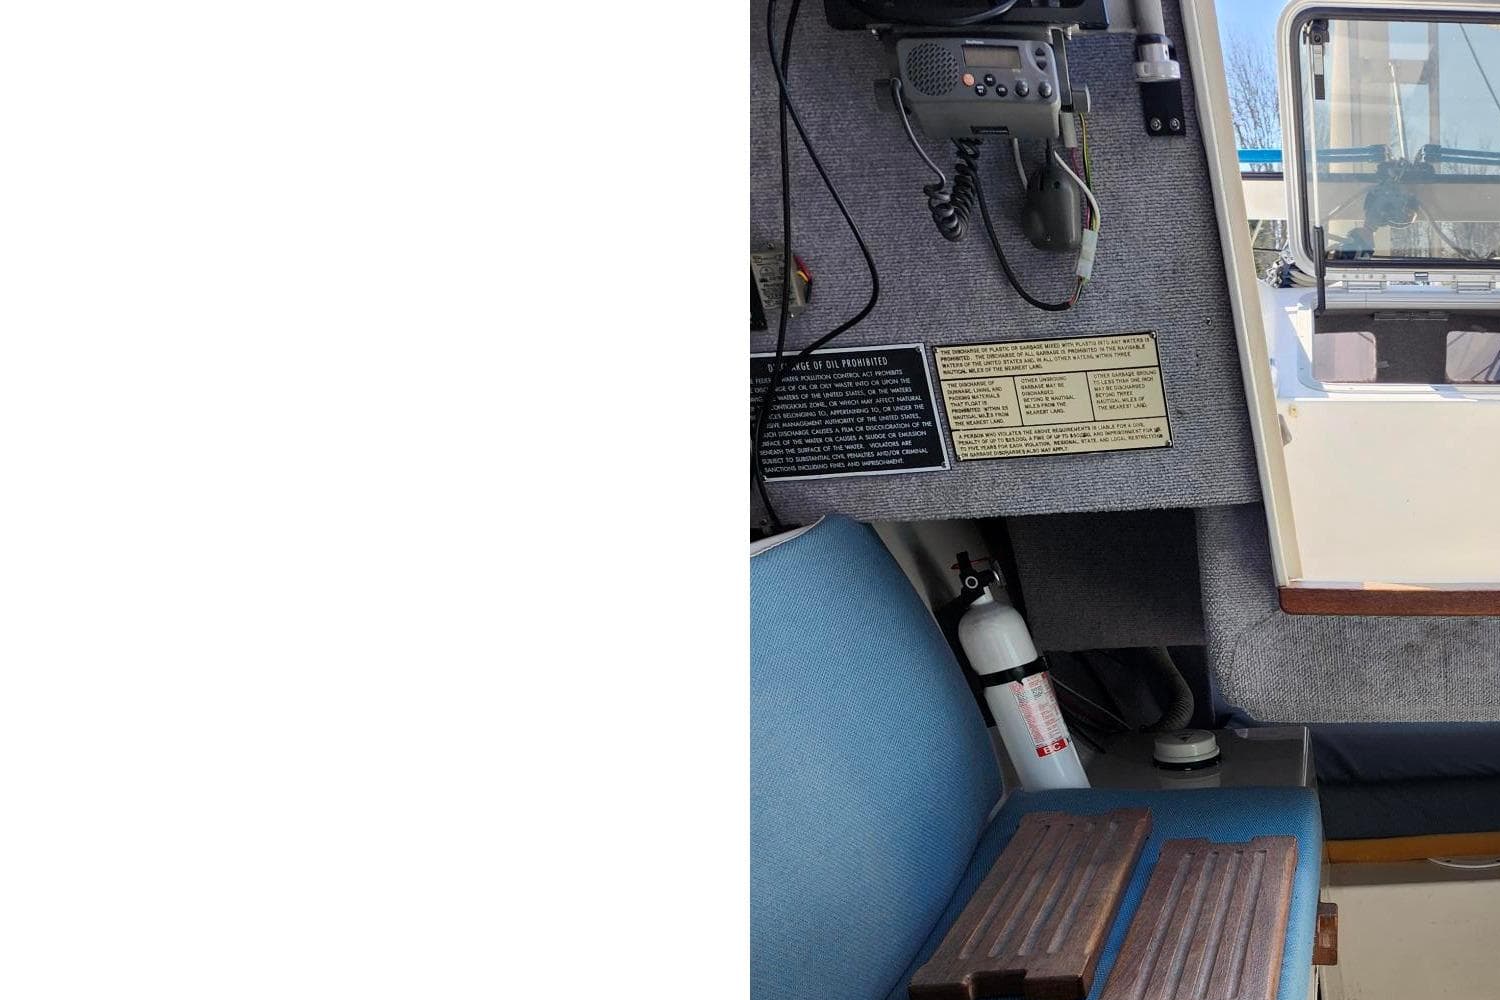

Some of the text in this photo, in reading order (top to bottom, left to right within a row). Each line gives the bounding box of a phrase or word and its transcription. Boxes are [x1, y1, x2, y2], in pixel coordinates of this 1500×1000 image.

[812, 360, 823, 369] OF
[825, 359, 839, 368] OIL
[841, 356, 888, 367] PROHIBITED
